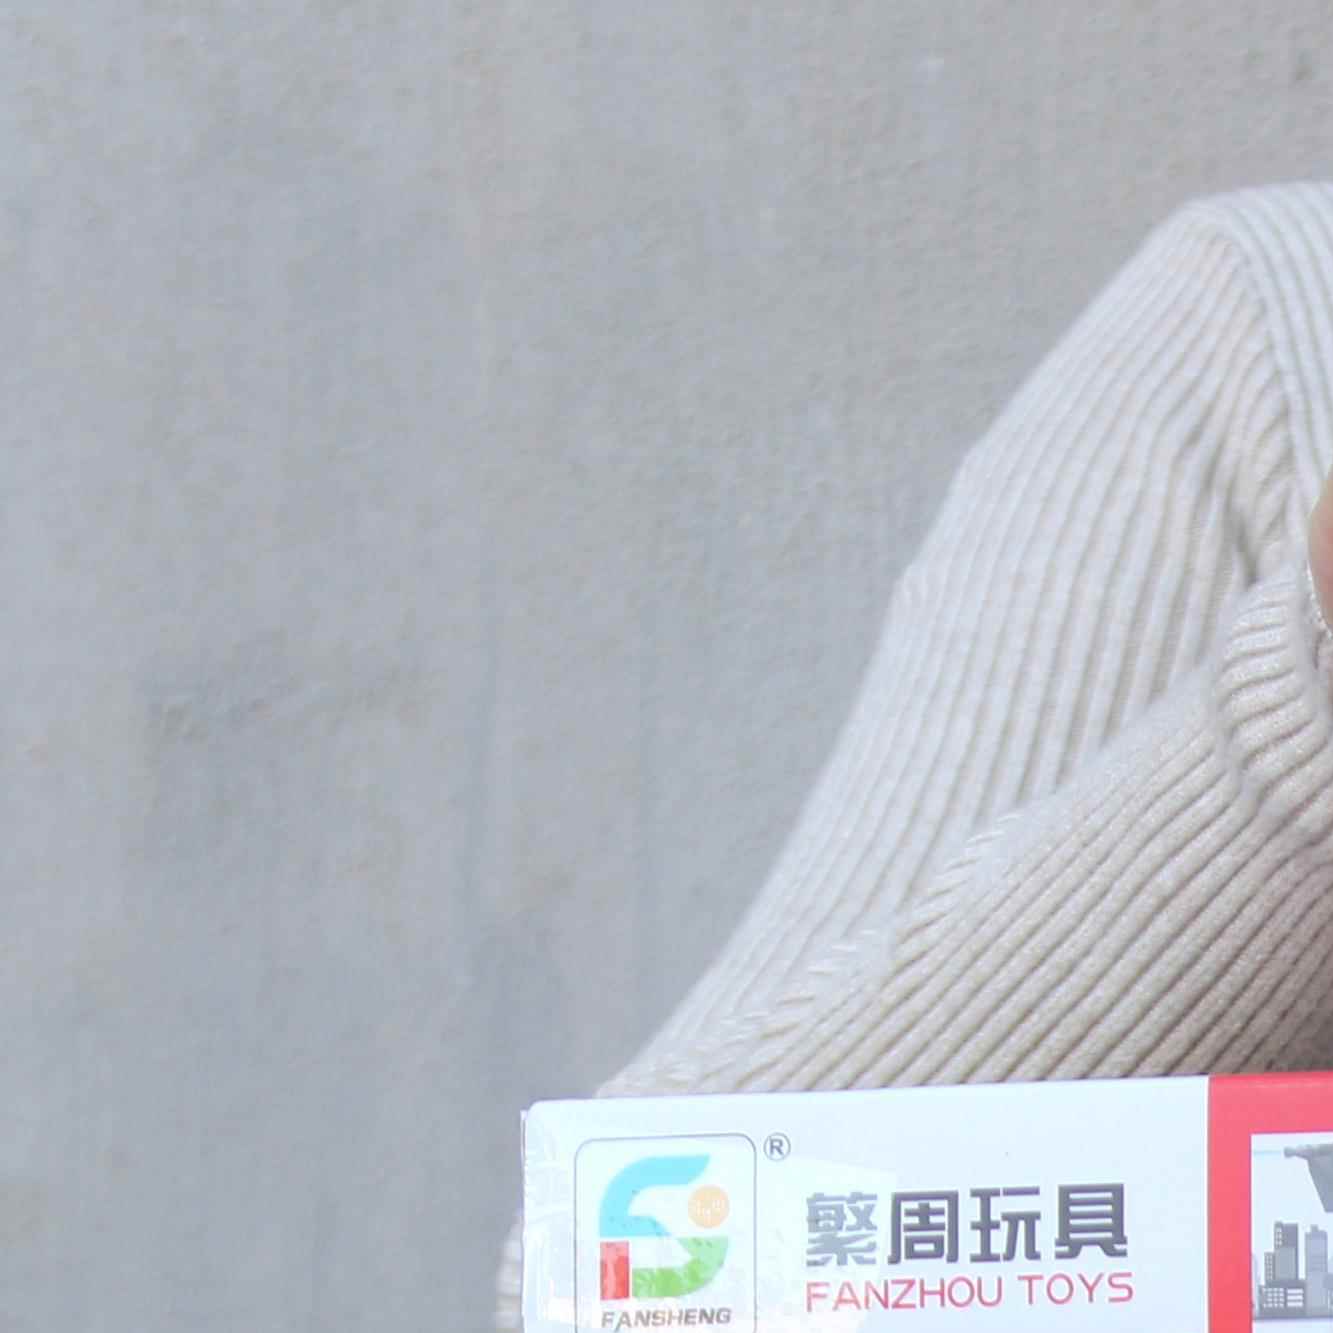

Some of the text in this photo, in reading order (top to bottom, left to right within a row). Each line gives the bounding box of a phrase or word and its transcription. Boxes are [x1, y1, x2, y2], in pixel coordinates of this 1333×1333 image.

[805, 1182, 1128, 1267] 繁周玩具
[805, 1271, 1134, 1312] FANZHOU TOYS
[600, 1307, 733, 1333] FANSHENG
